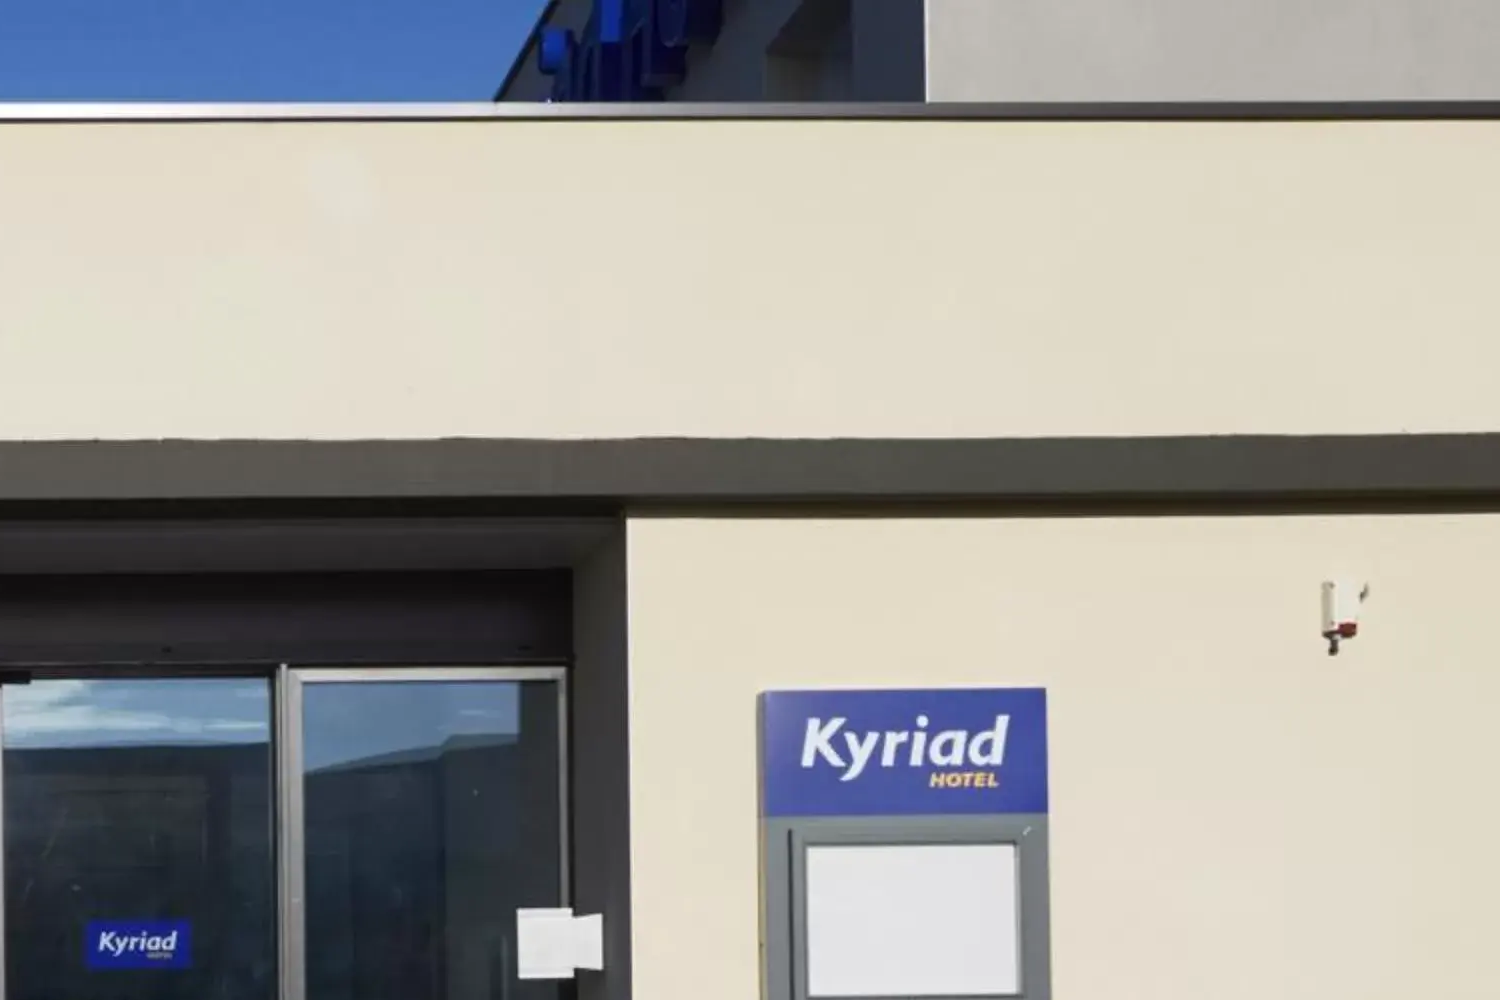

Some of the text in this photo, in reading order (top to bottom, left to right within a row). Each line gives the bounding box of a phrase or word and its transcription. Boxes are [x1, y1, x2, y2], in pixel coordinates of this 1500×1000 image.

[801, 714, 1011, 782] Kyriad
[928, 772, 1000, 788] HOTEL
[98, 929, 178, 957] Kyriad
